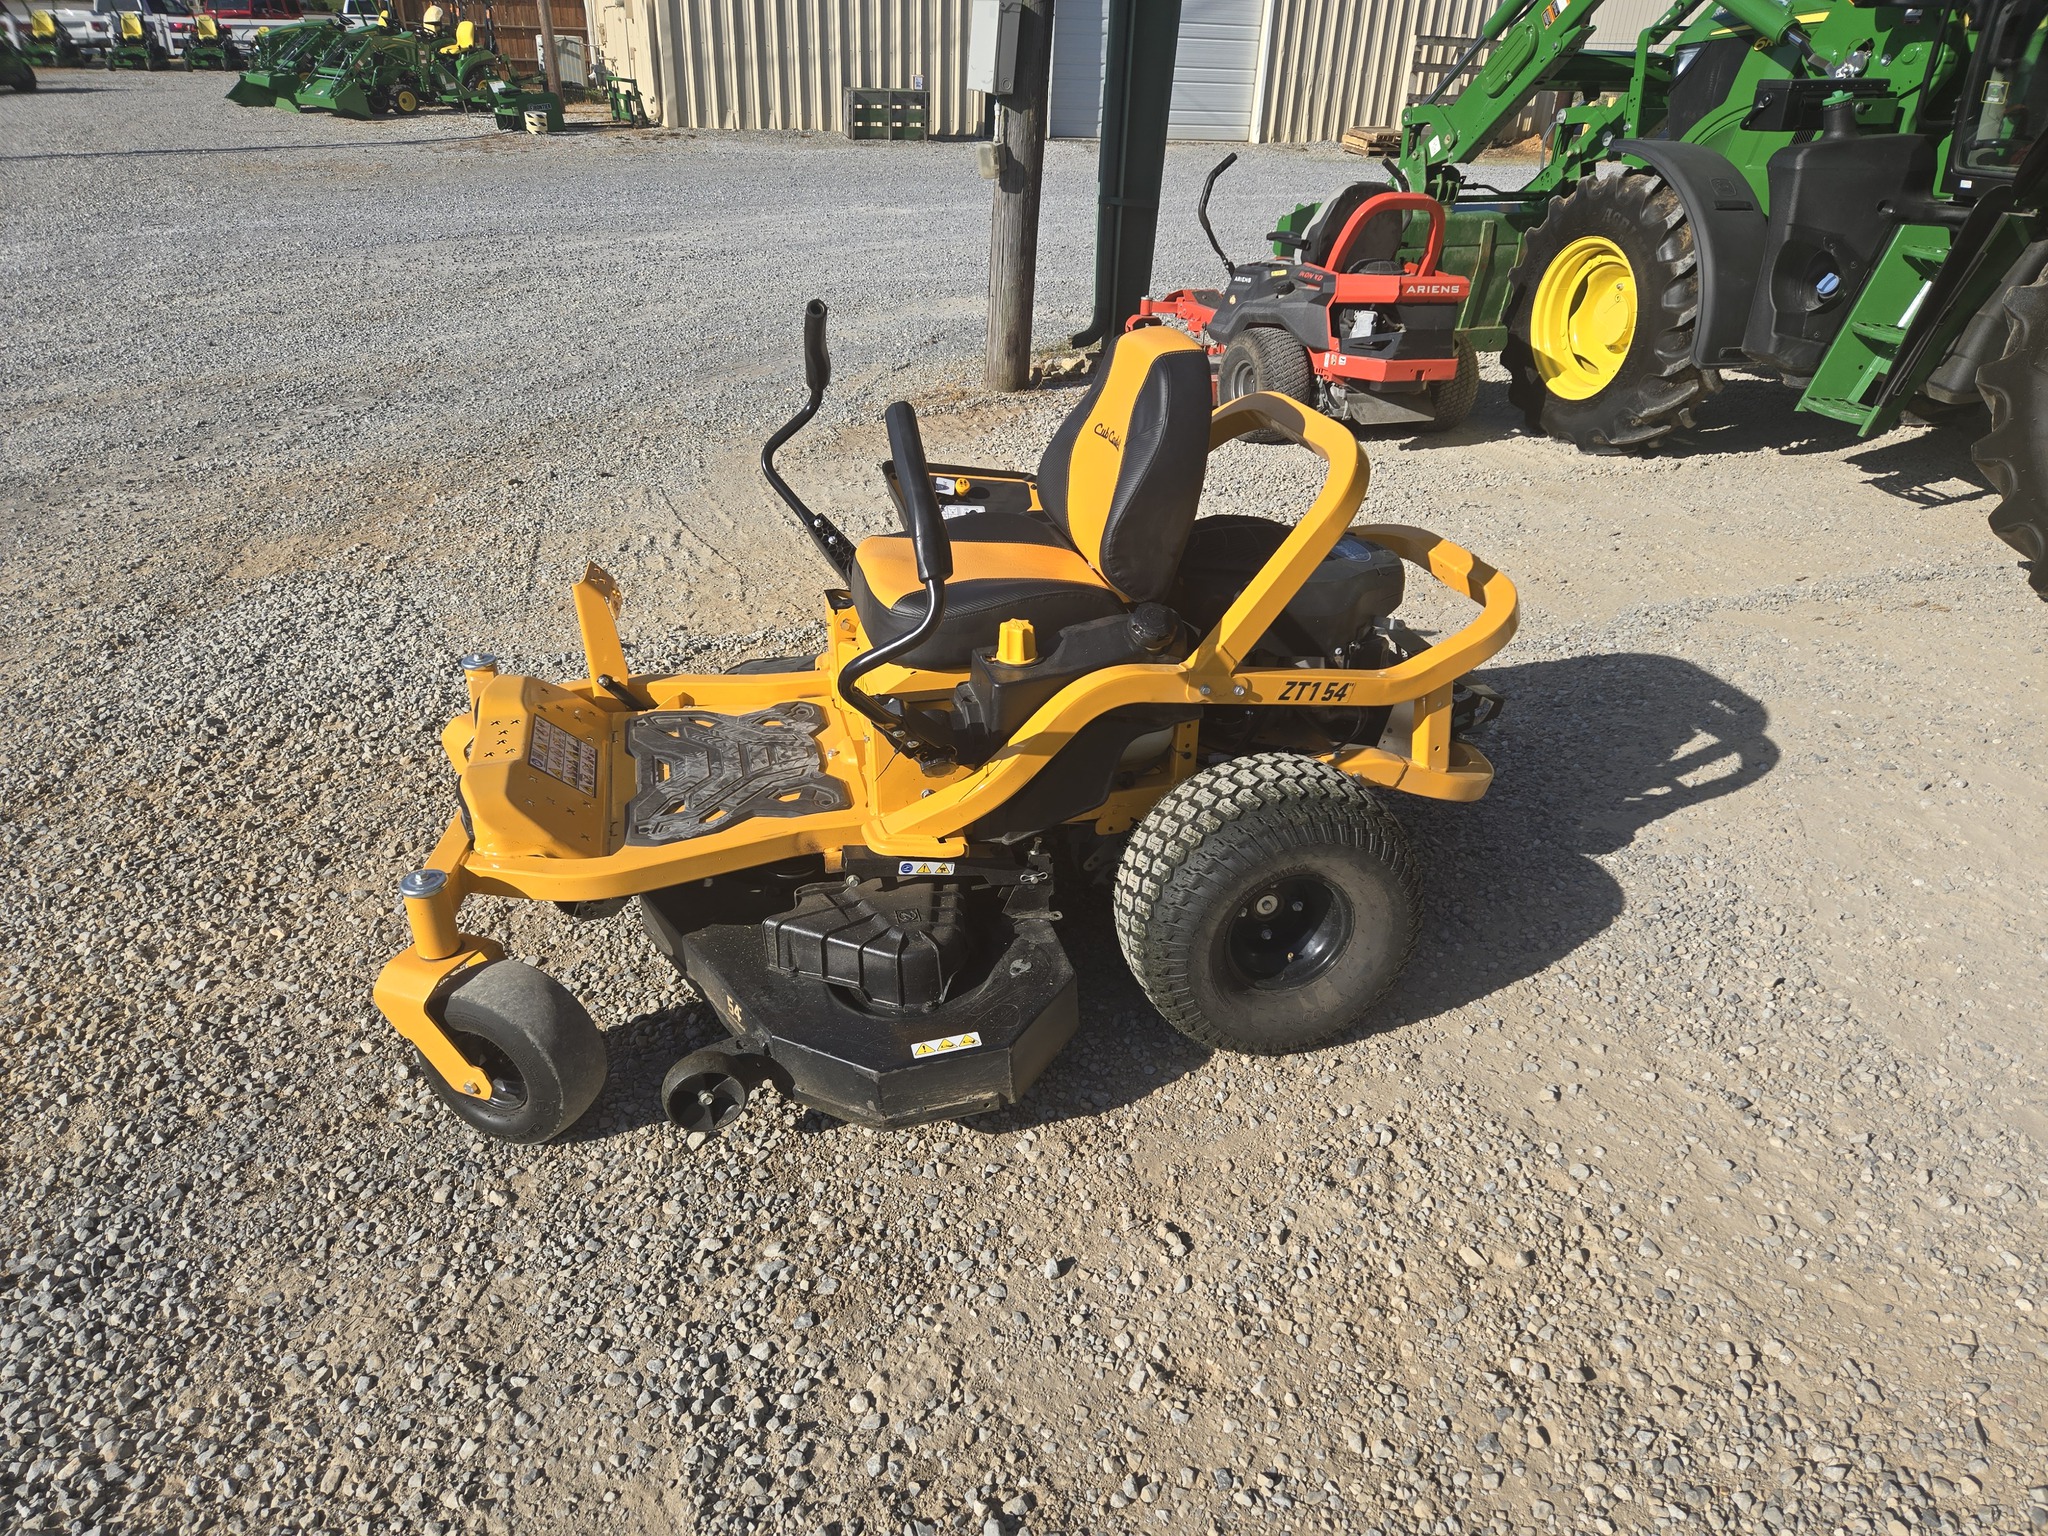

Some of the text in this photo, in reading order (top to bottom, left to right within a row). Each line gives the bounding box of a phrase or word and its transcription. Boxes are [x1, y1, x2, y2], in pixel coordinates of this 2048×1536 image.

[1234, 276, 1252, 284] ARIENS
[1406, 285, 1460, 294] ARIENS
[1094, 423, 1110, 439] Cub
[1278, 681, 1322, 701] ZT1
